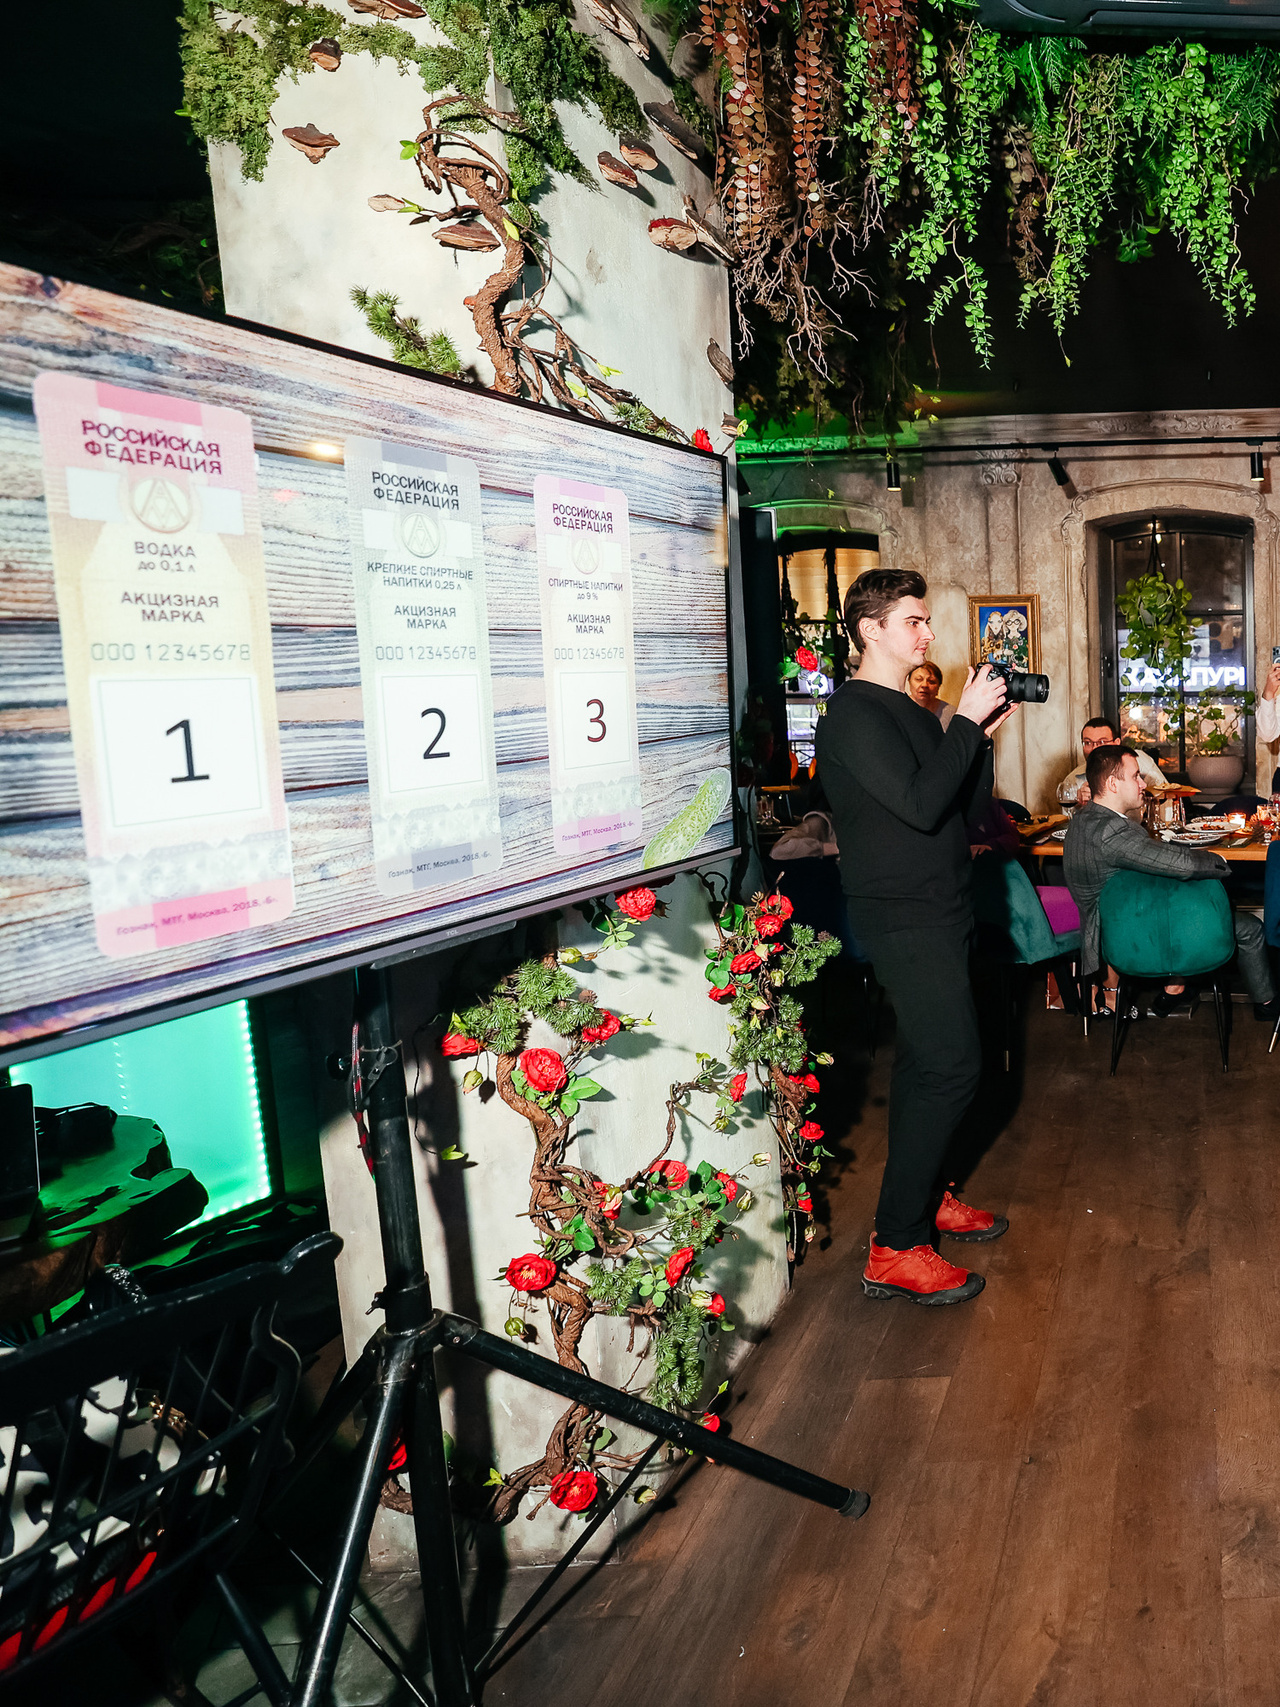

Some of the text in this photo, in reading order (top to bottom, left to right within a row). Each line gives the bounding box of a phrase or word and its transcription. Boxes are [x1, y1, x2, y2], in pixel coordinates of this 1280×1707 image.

[82, 420, 220, 457] РОССИЙСКАЯ
[85, 441, 222, 475] ФЕДЕРАЦИЯ
[372, 471, 458, 496] РОССИЙСКАЯ
[373, 487, 459, 510] ФЕДЕРАЦИЯ
[552, 503, 613, 522] РОССИЙСКАЯ
[553, 516, 613, 534] ФЕДЕРАЦИЯ
[134, 541, 196, 557] ВОДКА
[138, 562, 155, 571] до
[160, 560, 184, 572] 0,1
[367, 562, 473, 580] КРЕПКИЕ СПИРТНЫЕ
[383, 576, 432, 588] НАПИТКИ
[435, 580, 455, 590] 0,25
[548, 578, 623, 591] СПИРТНЫЕ НАПИТКИ
[121, 591, 219, 608] АКЦИЗНАЯ
[586, 592, 591, 600] 9
[141, 610, 205, 623] МАРКА
[394, 605, 456, 617] АКЦИЗНАЯ
[567, 613, 611, 624] АКЦИЗНАЯ
[407, 618, 447, 629] МАРКА
[576, 625, 604, 634] МАРКА
[91, 643, 250, 661] 000 12345678
[375, 646, 476, 660] 000 12345678
[554, 647, 625, 660] 000 12345678
[586, 698, 607, 742] 3
[420, 707, 451, 760] 2
[166, 719, 210, 783] 1
